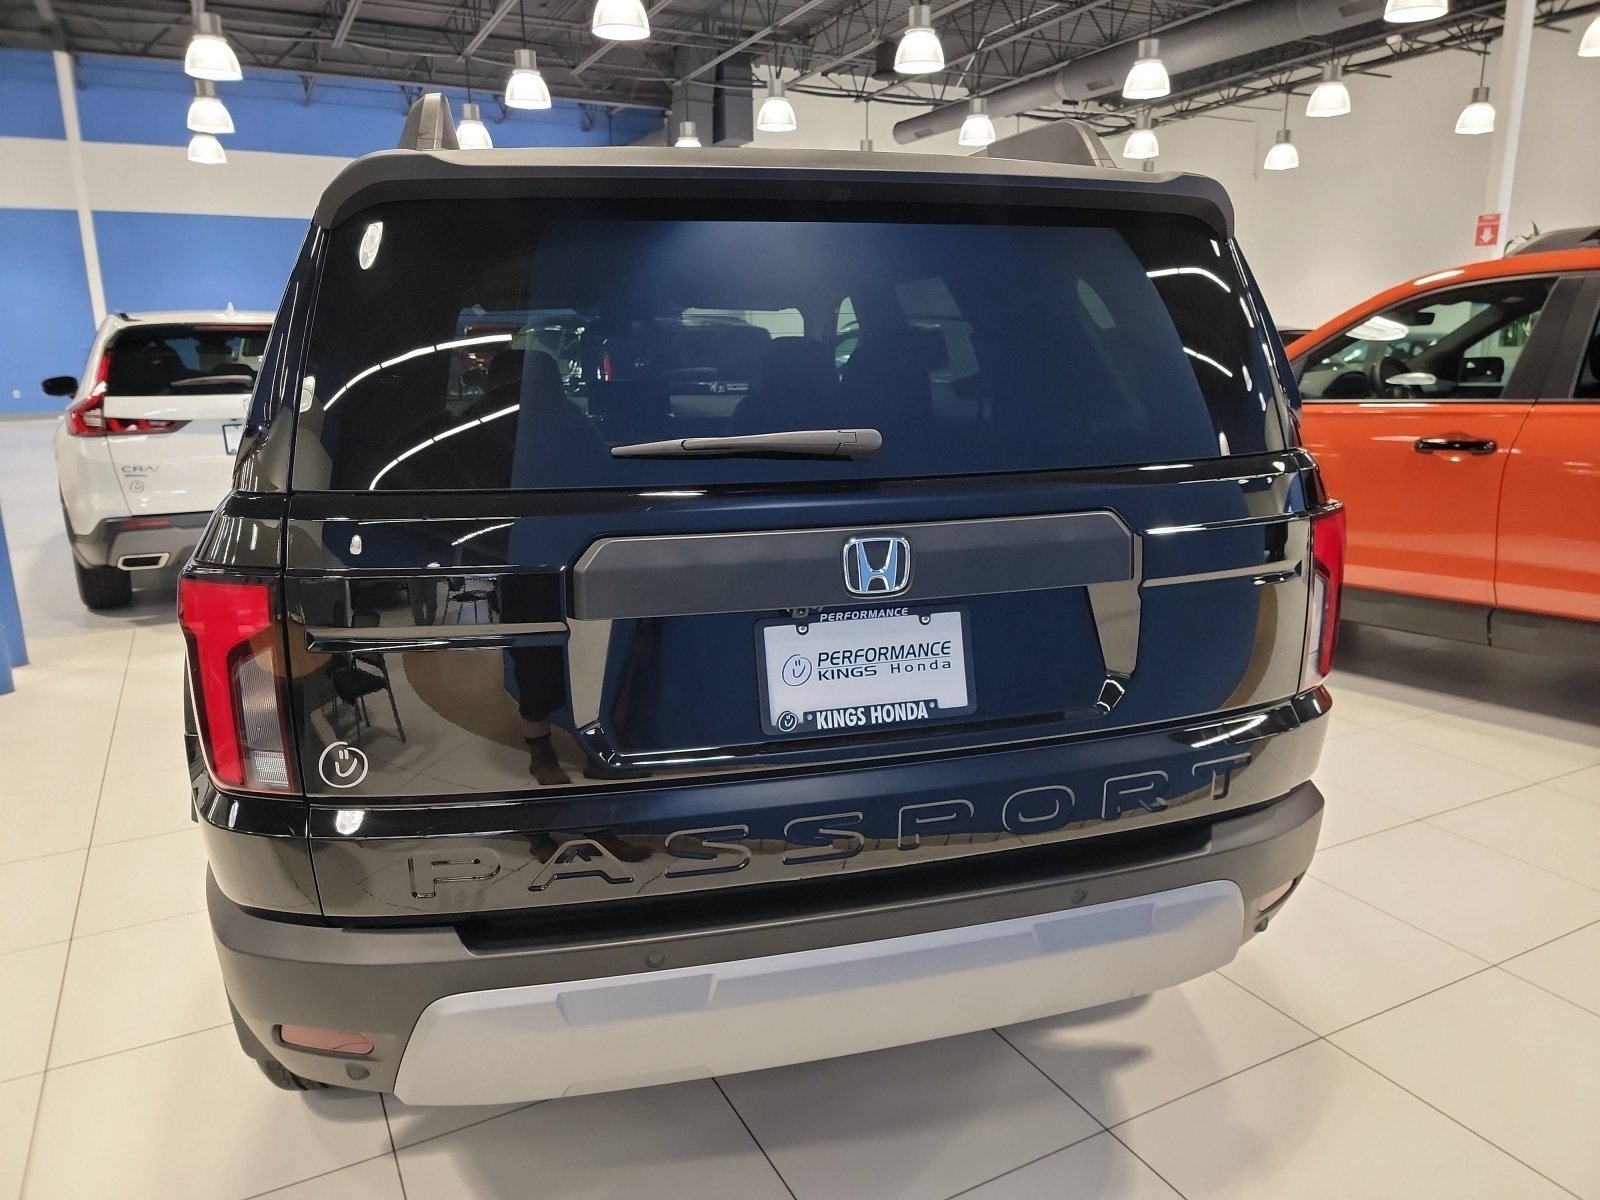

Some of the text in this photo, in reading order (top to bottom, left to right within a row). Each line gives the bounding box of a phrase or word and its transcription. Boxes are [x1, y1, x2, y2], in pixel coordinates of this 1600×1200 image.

[121, 465, 160, 473] CR-V
[820, 607, 909, 623] PERFORMANCE
[817, 640, 952, 667] PERFORMANCE
[818, 660, 952, 682] KINGS Honda
[816, 701, 929, 730] KINGS HONDA
[408, 752, 1252, 899] PASSPORT
